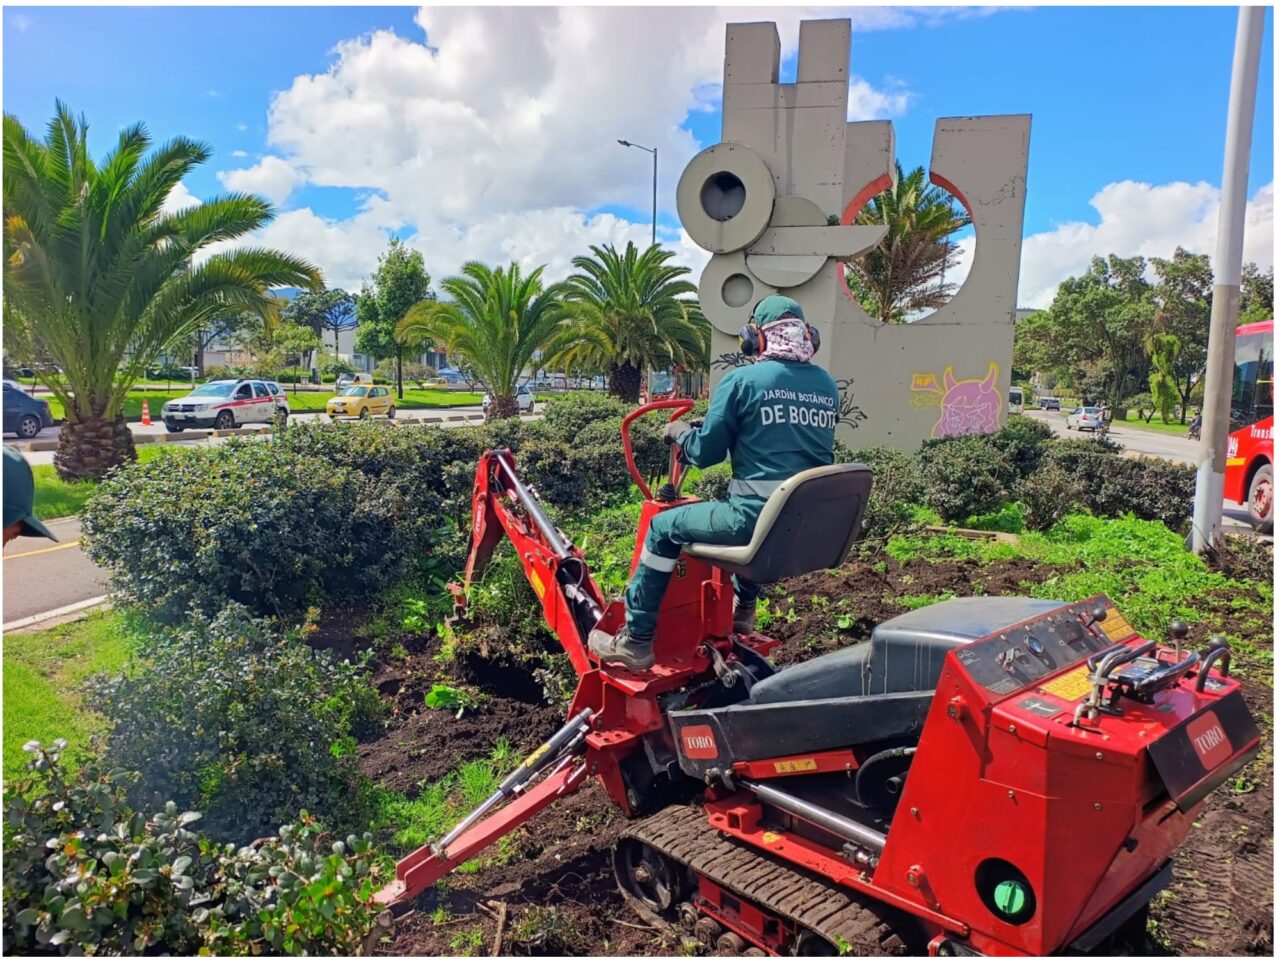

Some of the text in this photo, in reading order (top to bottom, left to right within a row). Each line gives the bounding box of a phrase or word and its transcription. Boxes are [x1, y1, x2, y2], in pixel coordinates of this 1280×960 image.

[760, 404, 786, 426] DE
[685, 735, 713, 749] TORO
[1194, 725, 1224, 755] TORO
